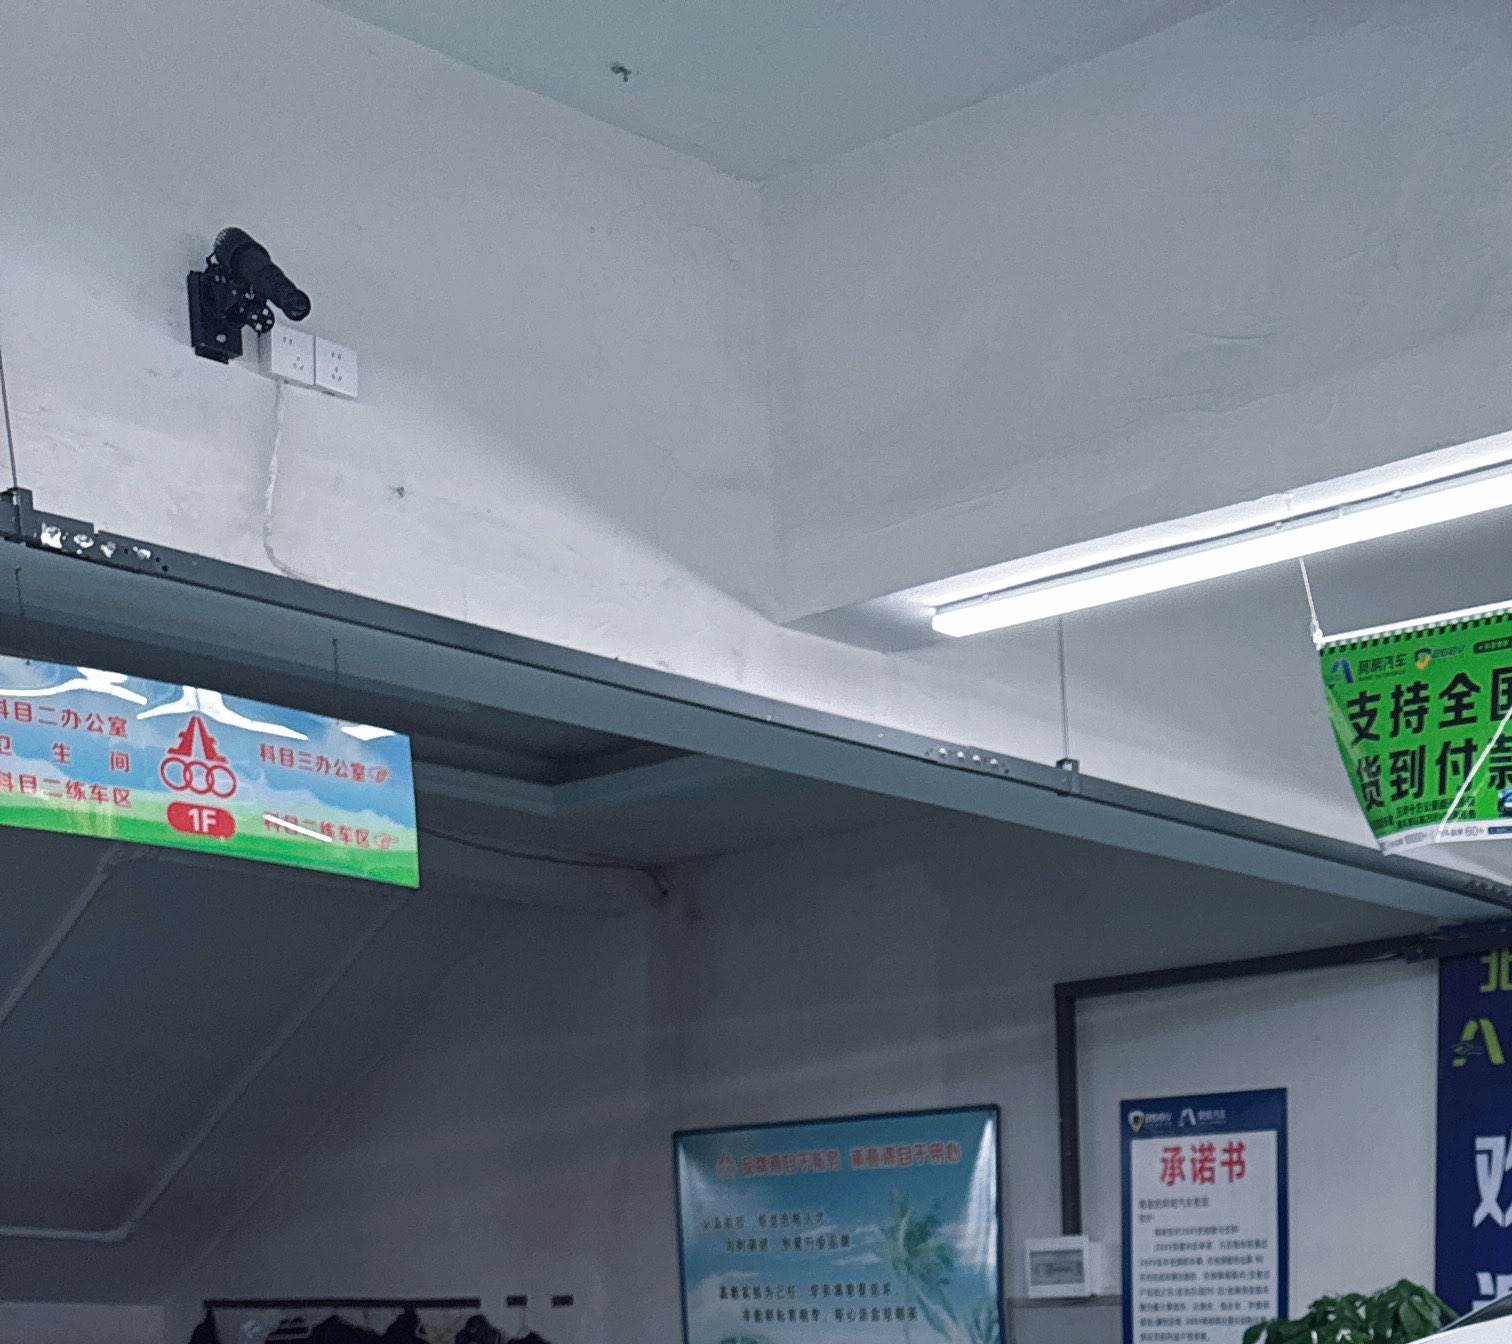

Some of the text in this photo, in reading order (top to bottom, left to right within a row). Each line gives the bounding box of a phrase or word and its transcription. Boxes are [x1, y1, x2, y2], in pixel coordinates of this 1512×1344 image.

[259, 743, 365, 783] 科目三办公室
[187, 807, 217, 832] 1F
[1160, 1140, 1246, 1187] 承诺书
